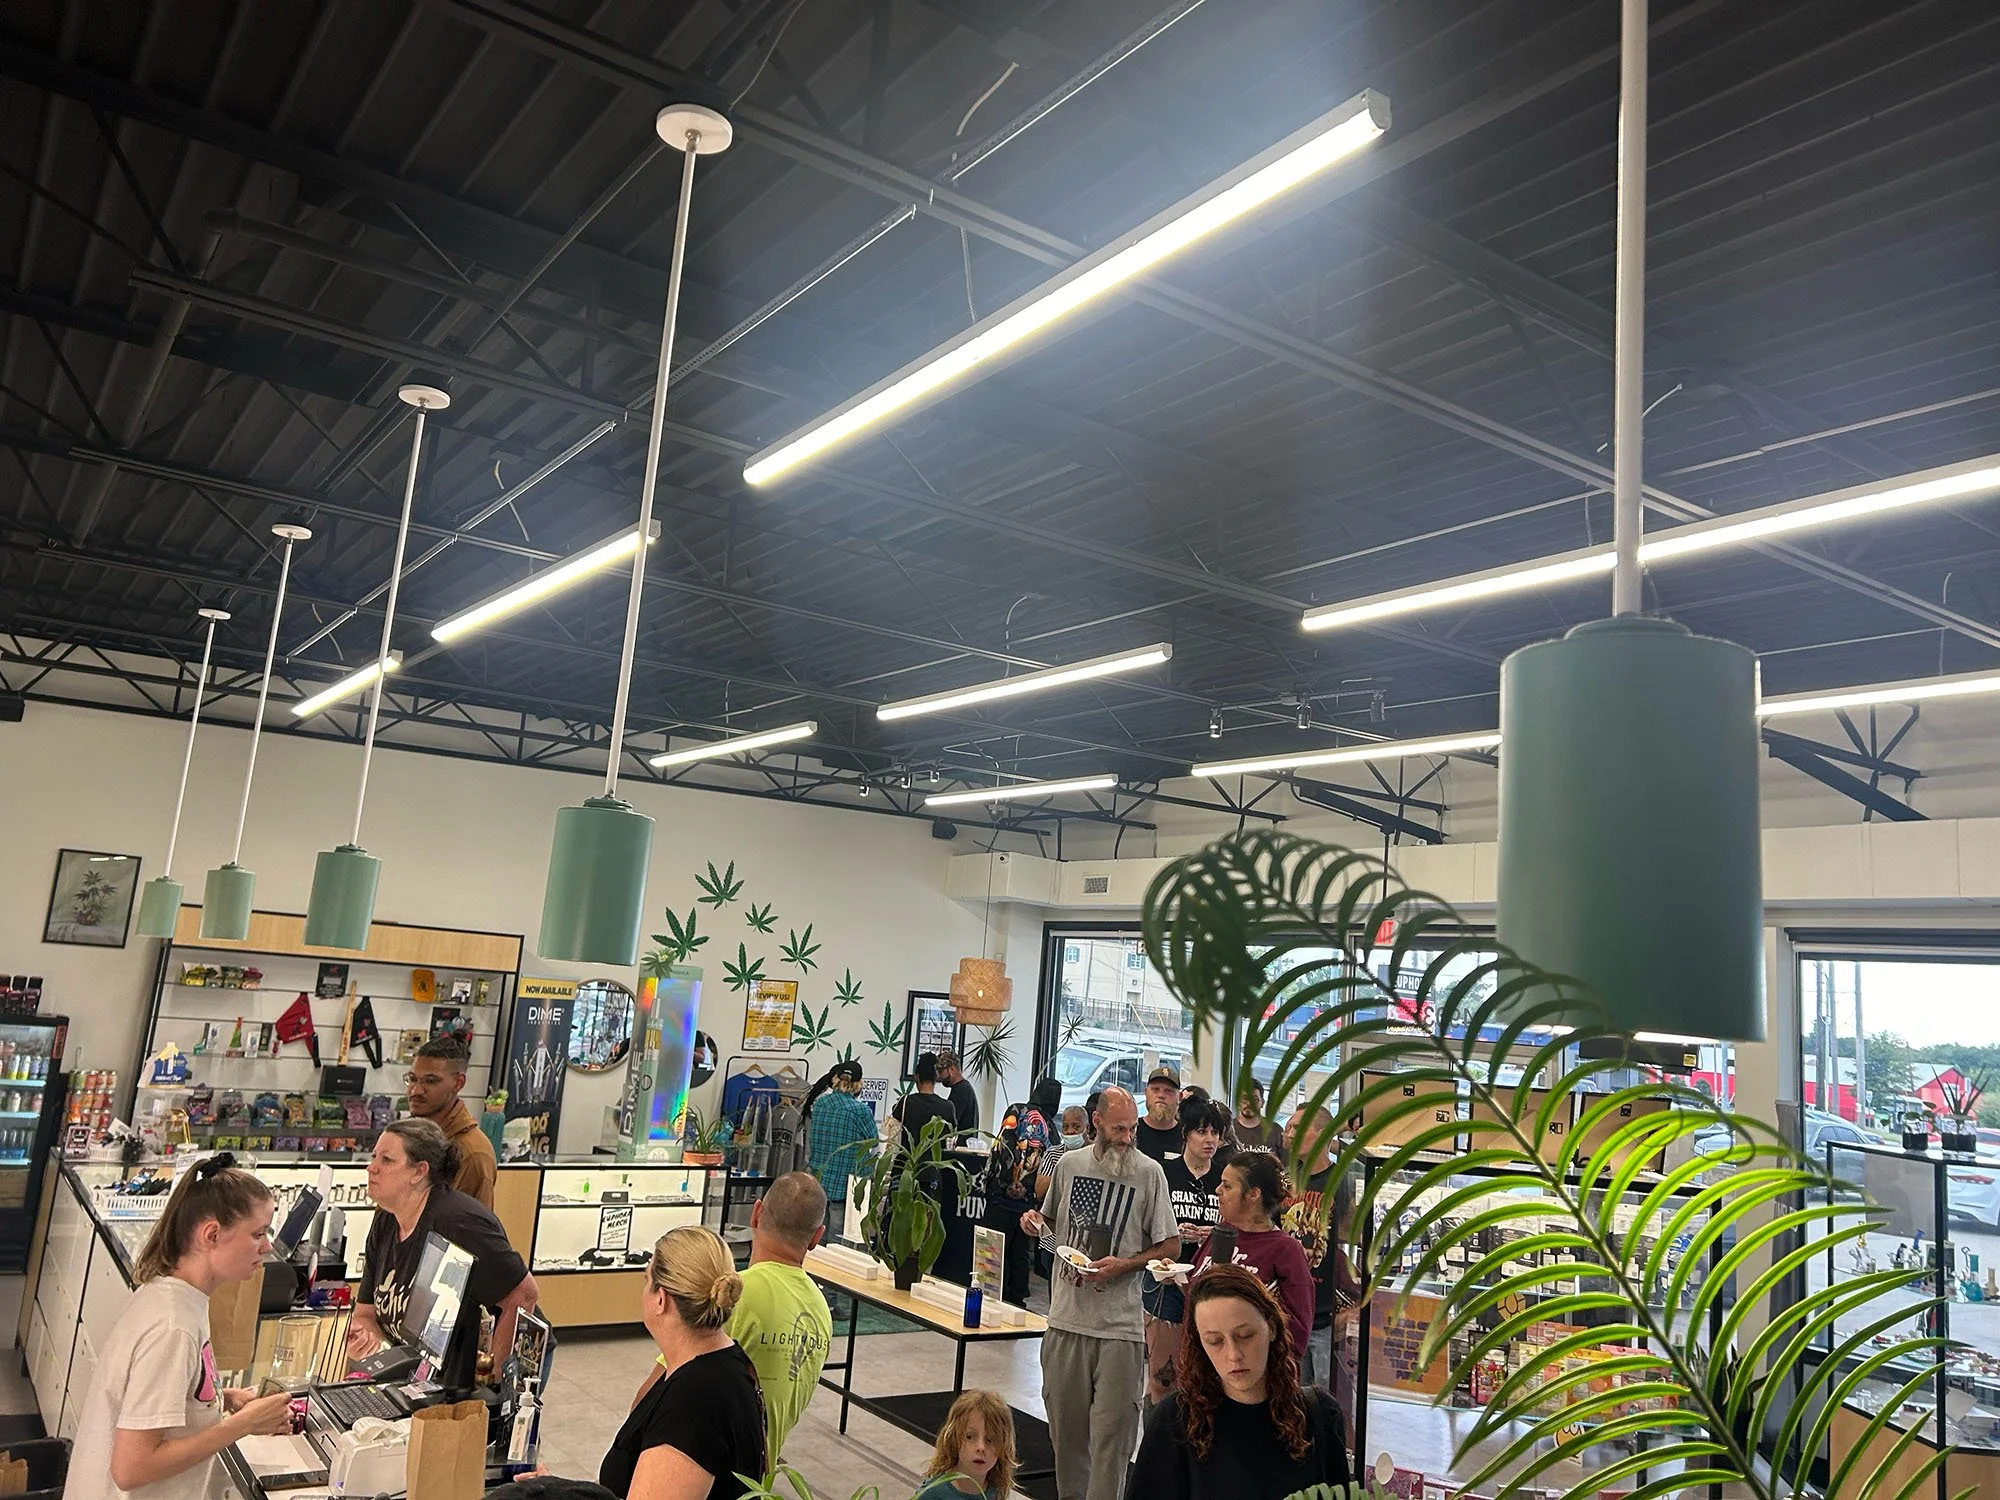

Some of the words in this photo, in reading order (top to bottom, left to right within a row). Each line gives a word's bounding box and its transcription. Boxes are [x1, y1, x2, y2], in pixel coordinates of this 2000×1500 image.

[526, 985, 541, 994] NOW
[541, 986, 573, 996] AVAILABLE
[528, 1006, 562, 1021] DIME
[622, 1051, 641, 1134] DIME
[862, 1080, 887, 1091] SERVED
[860, 1090, 883, 1101] ARKING
[1173, 1204, 1204, 1220] TAKIN'
[760, 1332, 829, 1352] LIGHTHOUS
